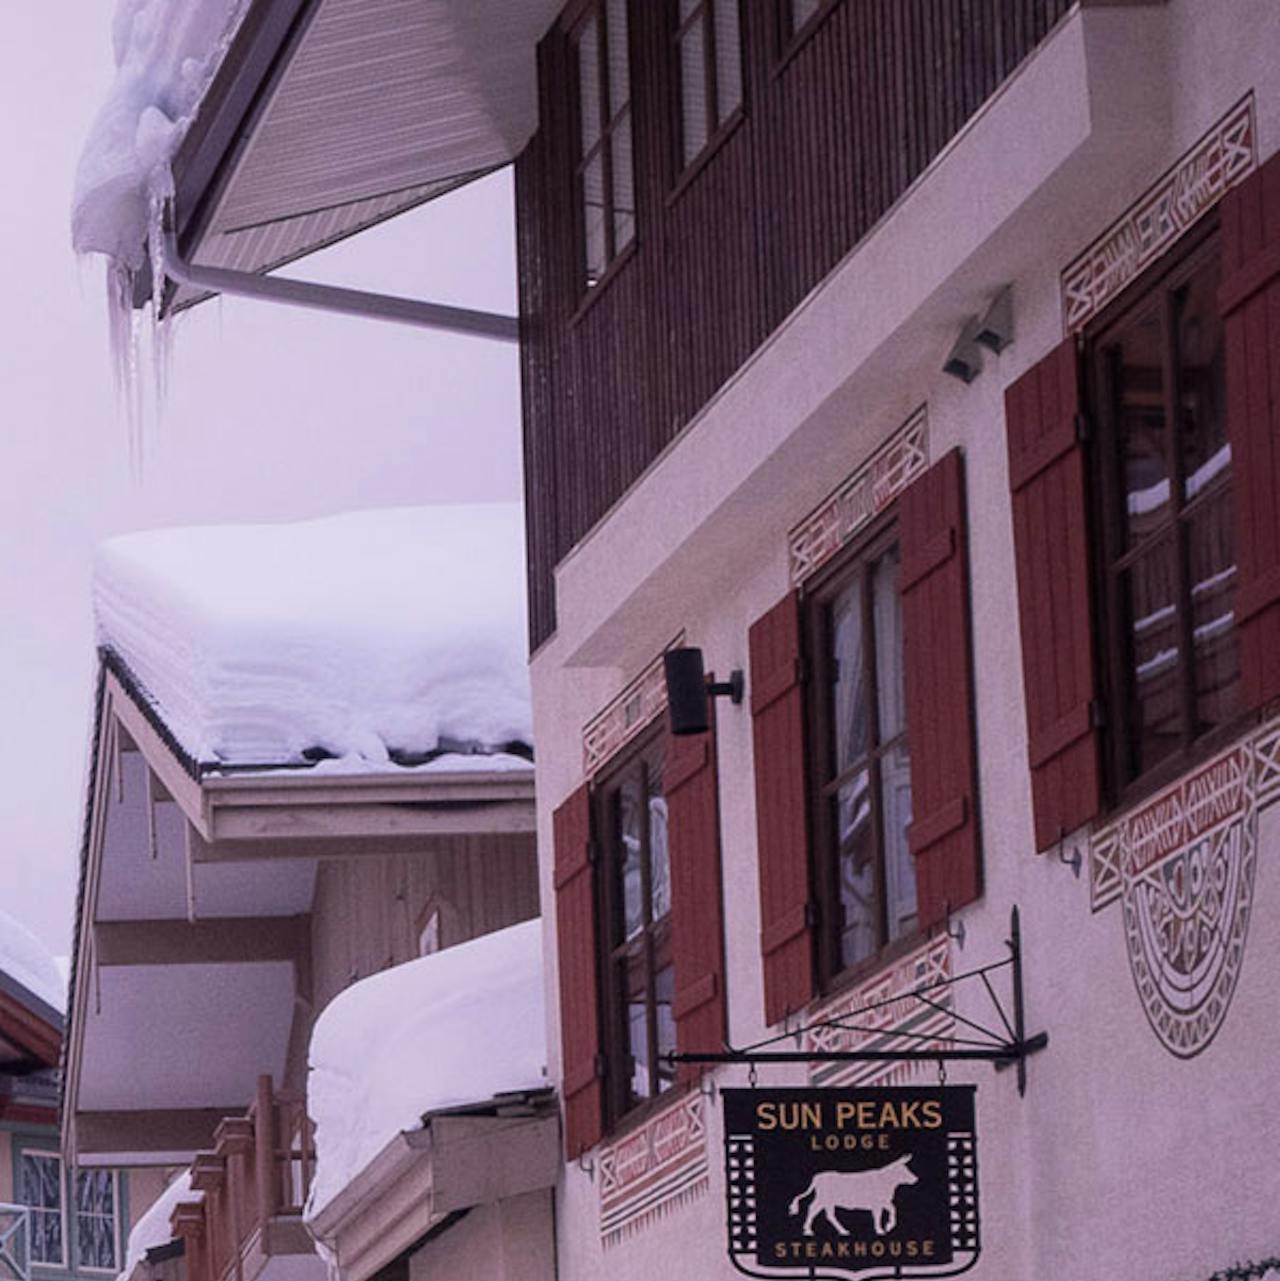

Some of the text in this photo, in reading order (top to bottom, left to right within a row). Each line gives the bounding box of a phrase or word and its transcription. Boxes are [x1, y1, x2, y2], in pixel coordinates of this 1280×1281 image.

[757, 1101, 942, 1130] SUN PEAKS
[811, 1134, 890, 1150] LODGE
[774, 1241, 935, 1258] STEAKHOUSE
